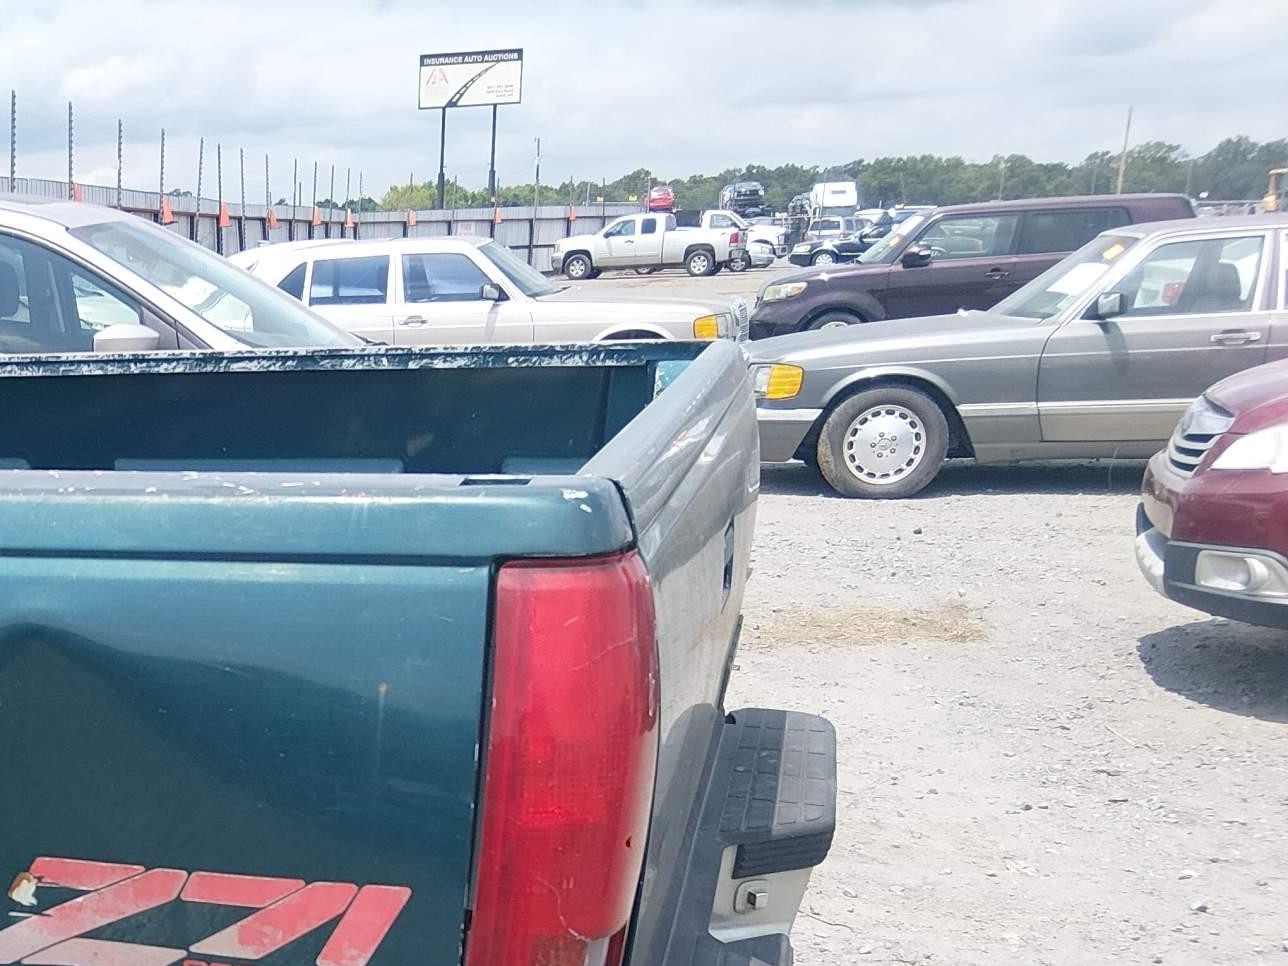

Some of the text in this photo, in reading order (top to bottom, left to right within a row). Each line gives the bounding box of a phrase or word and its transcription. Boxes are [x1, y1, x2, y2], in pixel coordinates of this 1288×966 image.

[423, 53, 518, 65] INSURANCE AUTO AUCTIONS
